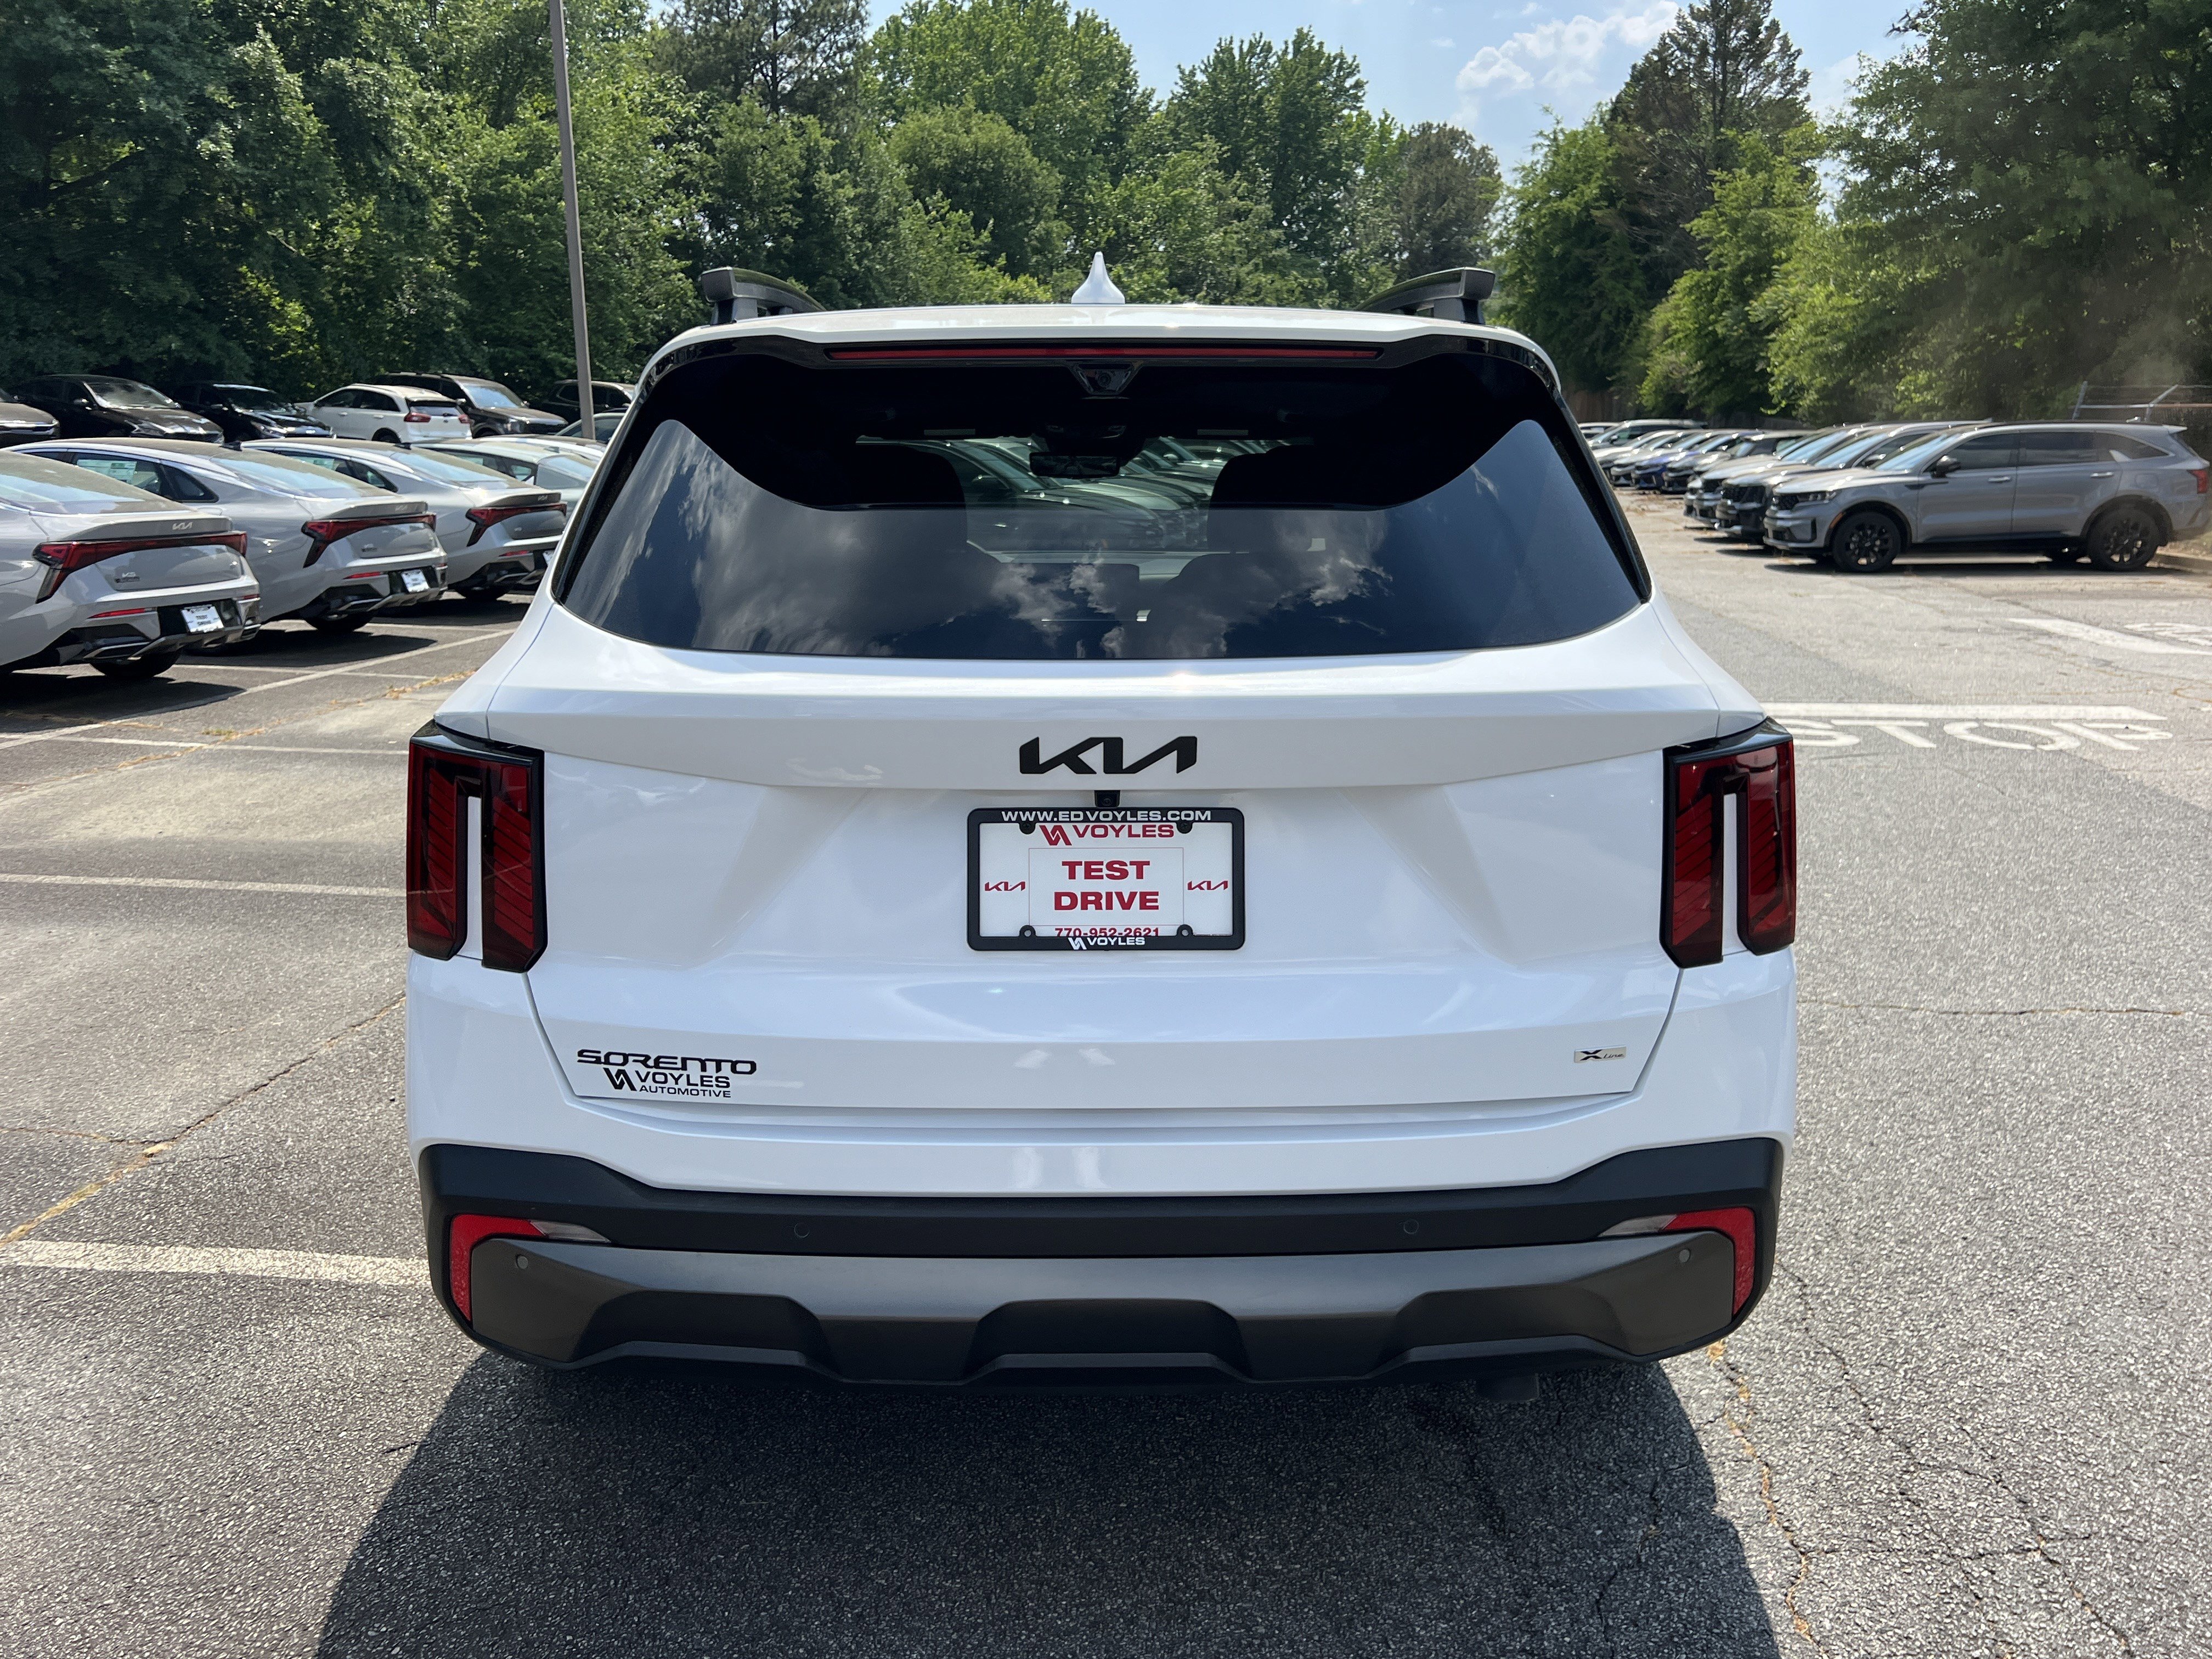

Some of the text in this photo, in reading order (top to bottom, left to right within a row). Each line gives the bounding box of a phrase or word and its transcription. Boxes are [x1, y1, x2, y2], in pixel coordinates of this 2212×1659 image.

[1019, 736, 1197, 775] KIA
[1073, 824, 1174, 838] VOYLES
[1062, 860, 1150, 880] TEST
[985, 881, 1025, 891] KIA
[1188, 881, 1228, 891] KIA
[1054, 891, 1160, 911] DRIVE
[1055, 928, 1159, 936] 770-952-2621
[1087, 936, 1146, 946] VOYLES
[577, 1048, 757, 1075] SORENTO
[635, 1070, 731, 1088] VOYLES
[639, 1085, 731, 1098] AUTOMOTIVE
